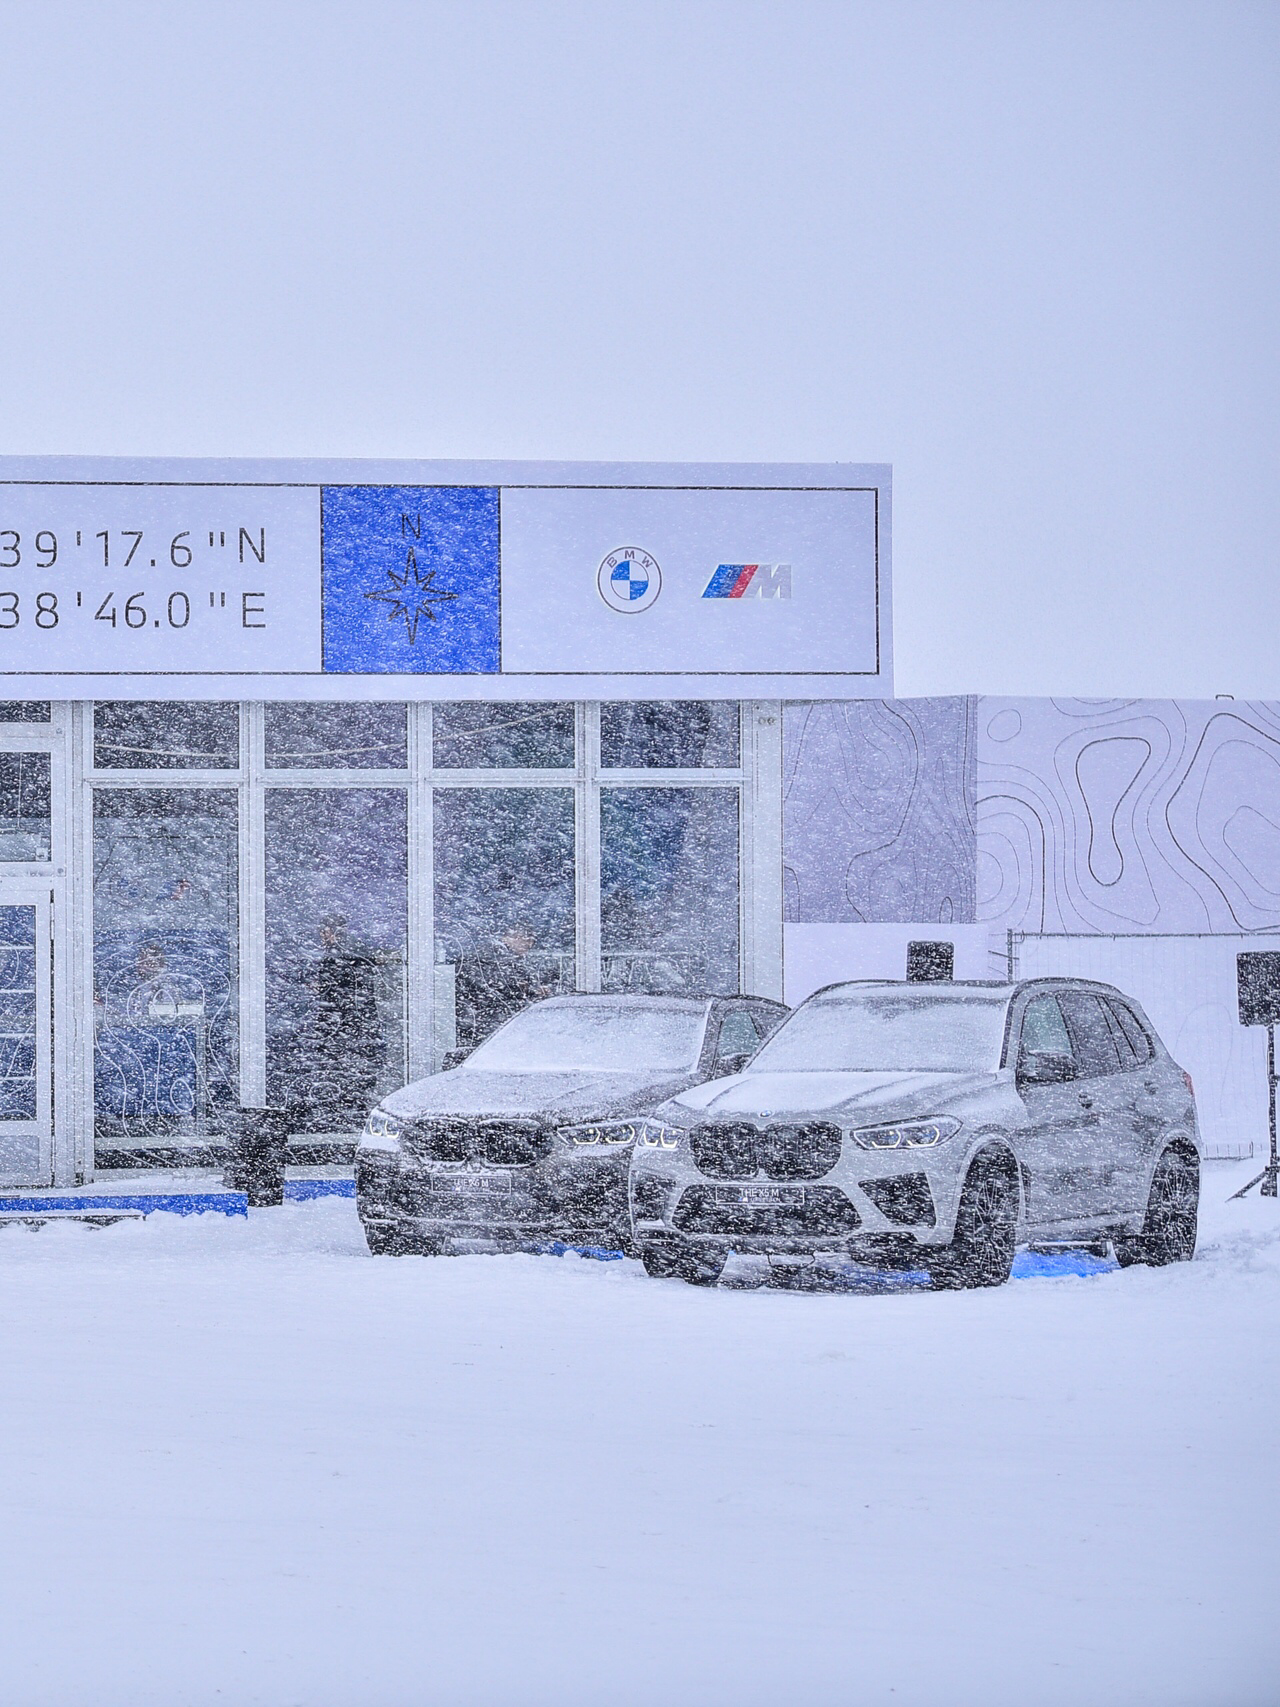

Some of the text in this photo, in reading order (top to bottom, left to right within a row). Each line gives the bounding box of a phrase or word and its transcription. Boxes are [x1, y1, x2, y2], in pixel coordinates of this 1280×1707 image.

[401, 513, 421, 539] N
[740, 1188, 779, 1197] THE X5 M
